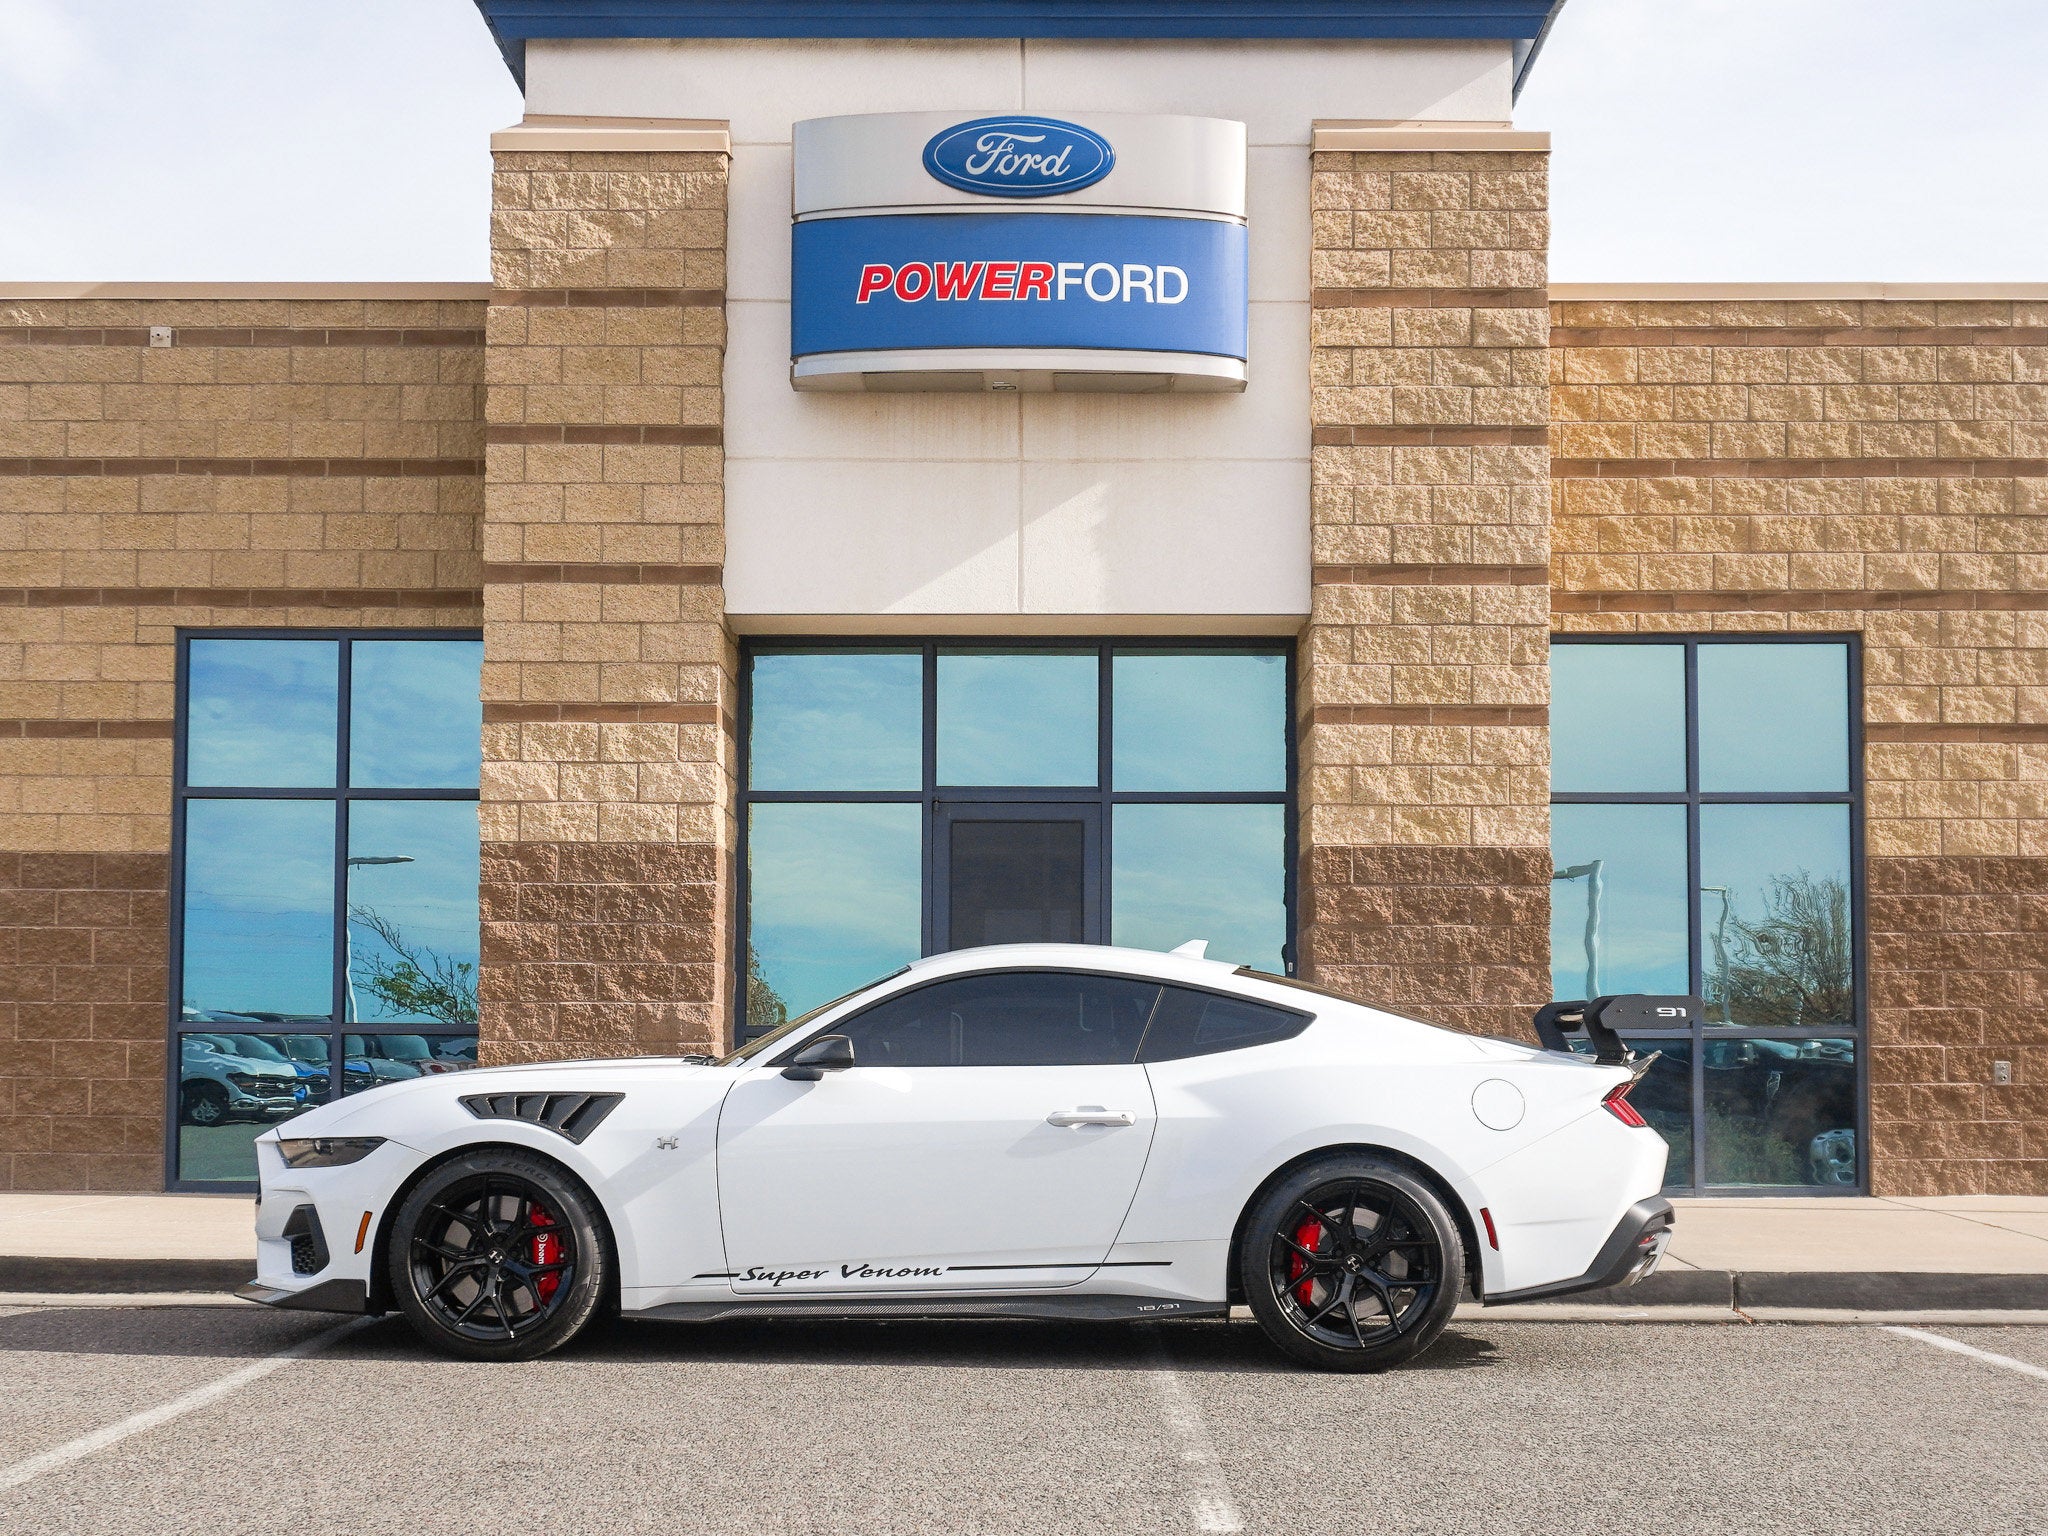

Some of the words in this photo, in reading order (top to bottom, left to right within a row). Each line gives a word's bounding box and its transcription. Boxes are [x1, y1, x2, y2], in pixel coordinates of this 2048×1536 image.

[966, 132, 1072, 177] Ford
[1656, 1007, 1687, 1018] 91
[739, 1266, 830, 1287] Super
[840, 1263, 943, 1279] Venom
